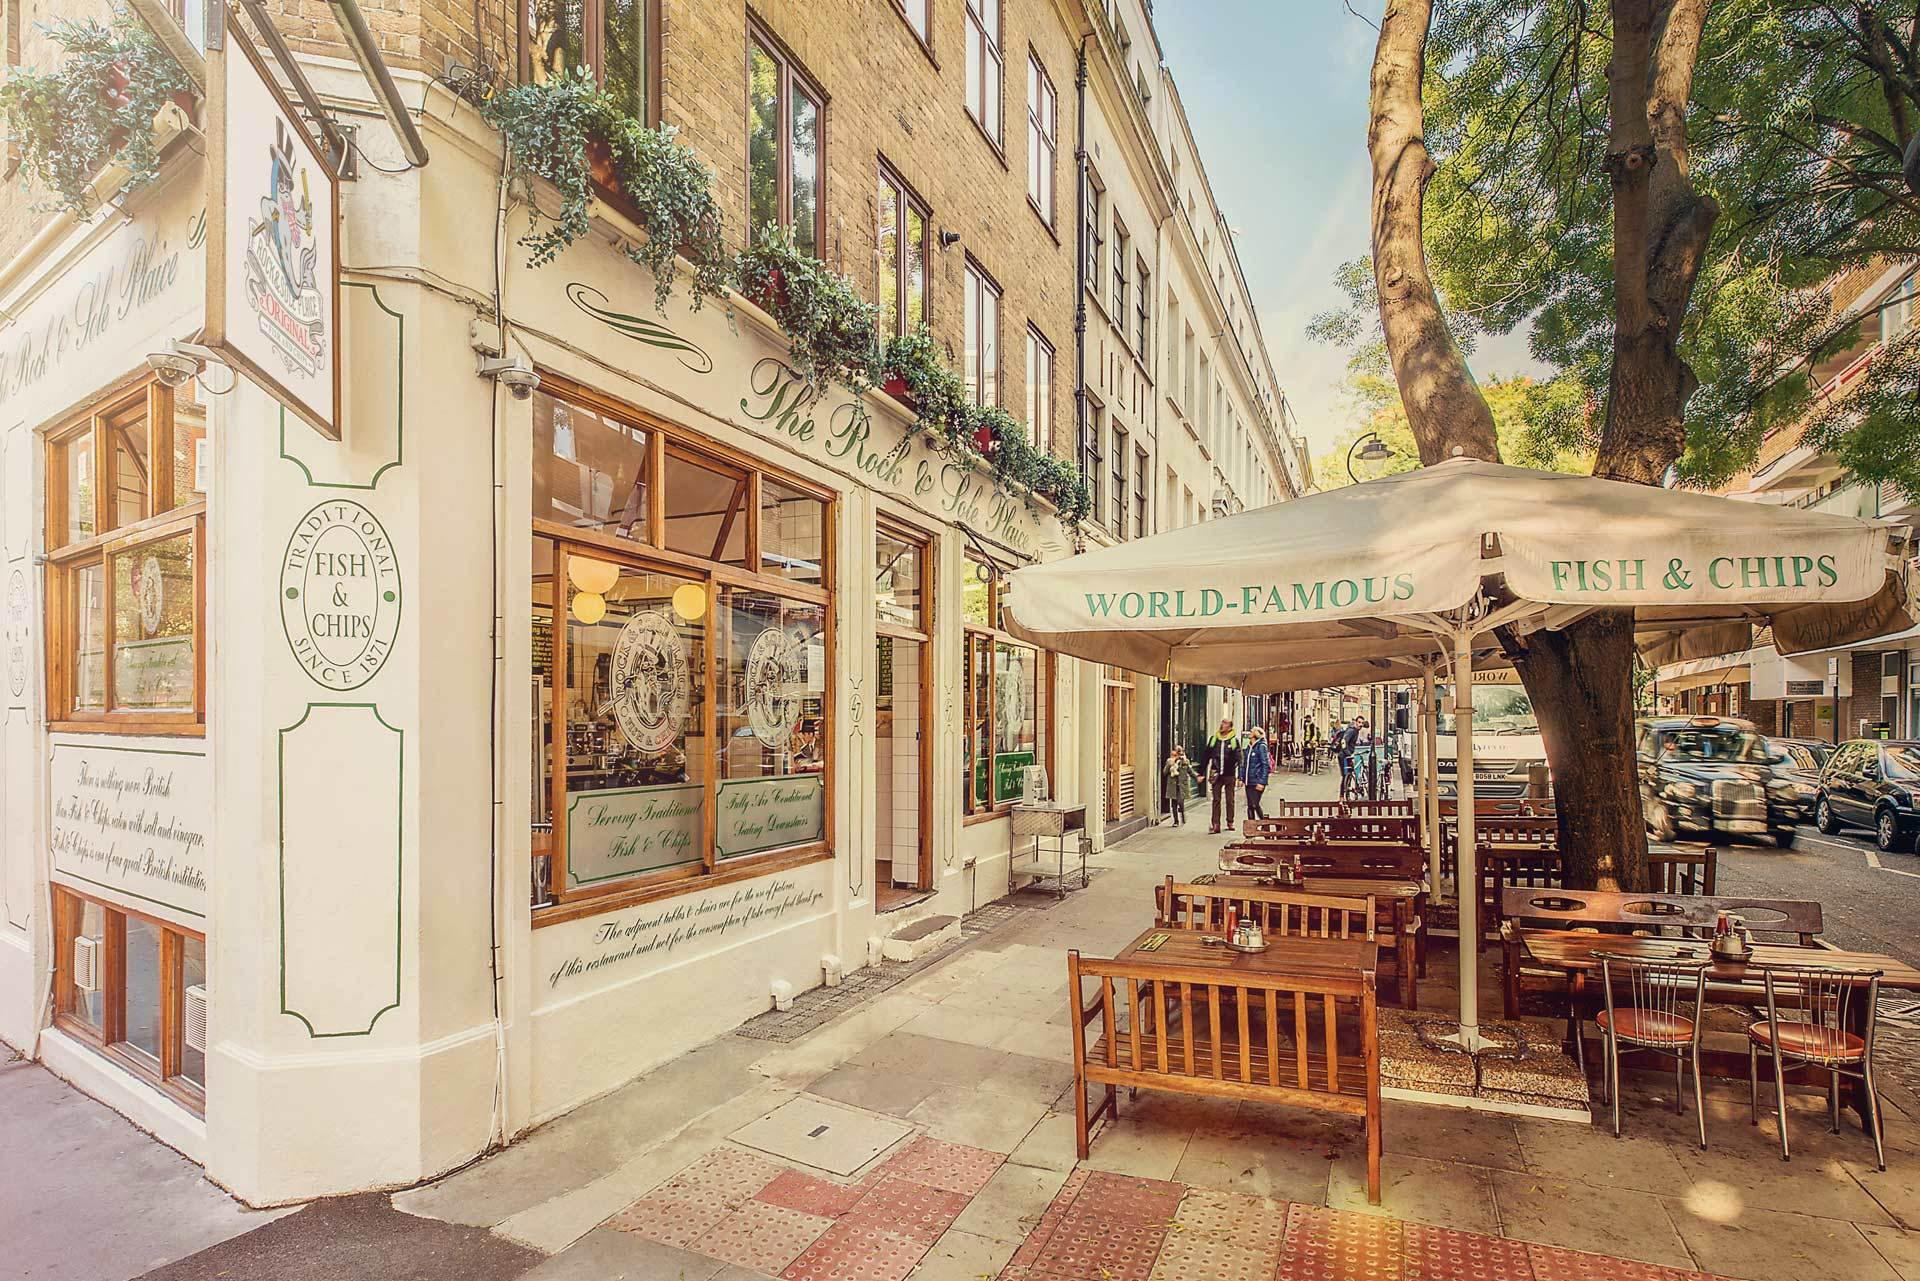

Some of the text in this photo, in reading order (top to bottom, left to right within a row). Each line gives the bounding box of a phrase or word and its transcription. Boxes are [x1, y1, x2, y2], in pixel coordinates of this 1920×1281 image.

[75, 265, 114, 350] Sole
[118, 232, 178, 320] Plaice
[266, 293, 310, 350] ORIGINAL
[741, 357, 1031, 550] The Rock & Sole Plaice
[288, 506, 393, 577] TRADITIONAL
[315, 552, 366, 577] FISH
[1550, 554, 1839, 592] FISH & CHIPS
[332, 582, 349, 607] &
[1084, 572, 1415, 619] WORLD-FAMOUS
[312, 613, 370, 638] CHIPS
[294, 638, 387, 683] SINCE 1871
[615, 642, 631, 695] ROCK
[143, 766, 173, 798] British
[725, 788, 815, 812] Fully Air Conditioned
[158, 815, 175, 841] and
[588, 805, 637, 831] Serving
[734, 815, 808, 837] Seating Downstairs
[607, 830, 692, 858] Fish & Chips
[143, 848, 173, 881] British
[595, 920, 622, 944] The
[625, 913, 663, 941] adjacent
[664, 905, 685, 923] tables
[695, 899, 717, 916] chairs
[730, 890, 742, 911] for
[745, 888, 755, 901] the
[549, 960, 568, 989] of
[565, 957, 583, 977] this
[586, 943, 637, 971] restaurant
[636, 934, 658, 955] and
[656, 933, 672, 950] not
[668, 928, 684, 951] for
[686, 923, 697, 940] the
[698, 914, 741, 935] consumption
[742, 906, 752, 927] of
